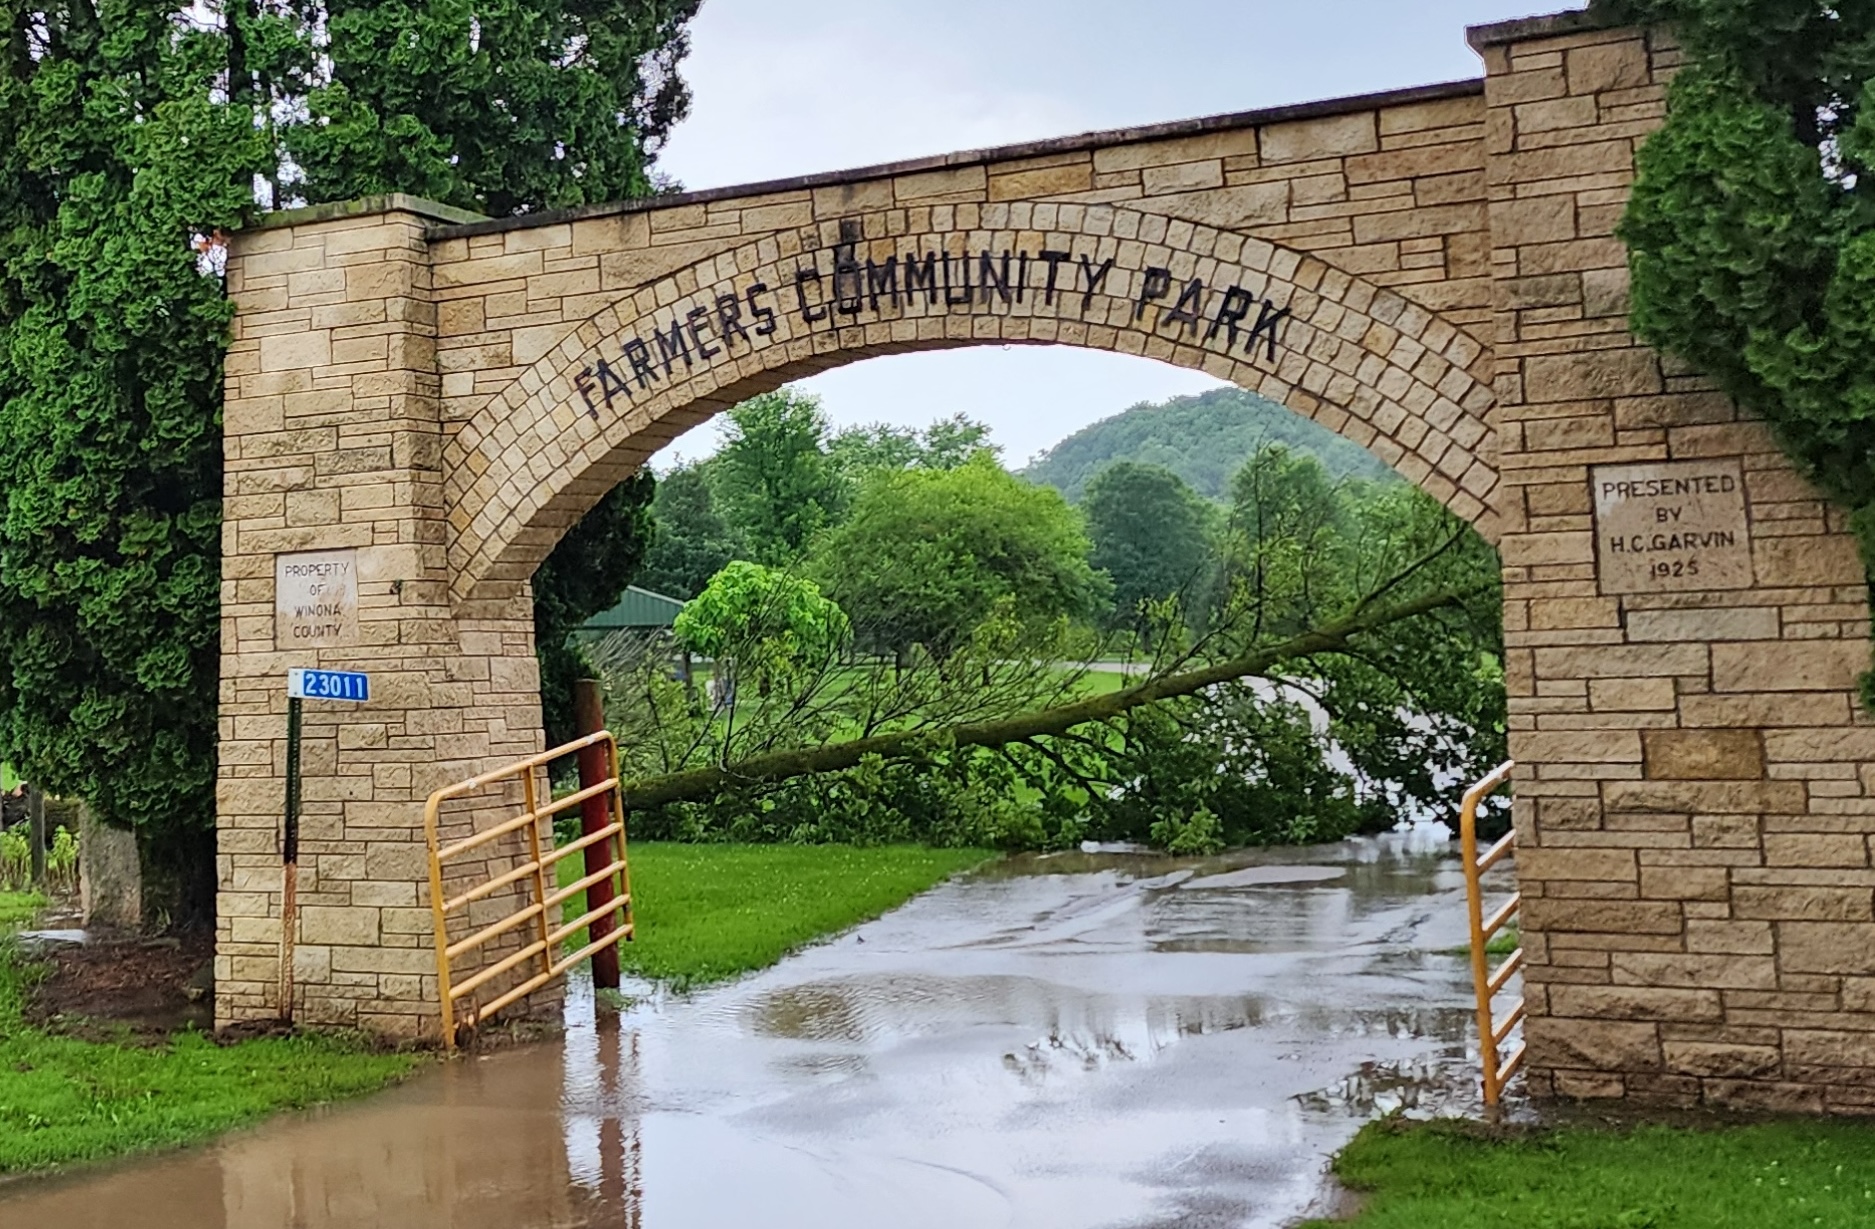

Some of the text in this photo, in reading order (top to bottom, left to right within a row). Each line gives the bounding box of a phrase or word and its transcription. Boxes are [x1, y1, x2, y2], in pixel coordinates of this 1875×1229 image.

[574, 250, 1291, 420] FARMERS COMMUNITY PARK
[1602, 475, 1735, 499] PRESENTED
[1656, 507, 1682, 523] BY
[285, 562, 349, 577] PROPERTY
[1651, 560, 1699, 580] 1925
[309, 584, 326, 596] OF
[294, 602, 342, 618] WINONA
[293, 624, 342, 639] COUNTY
[305, 673, 363, 698] 23011
